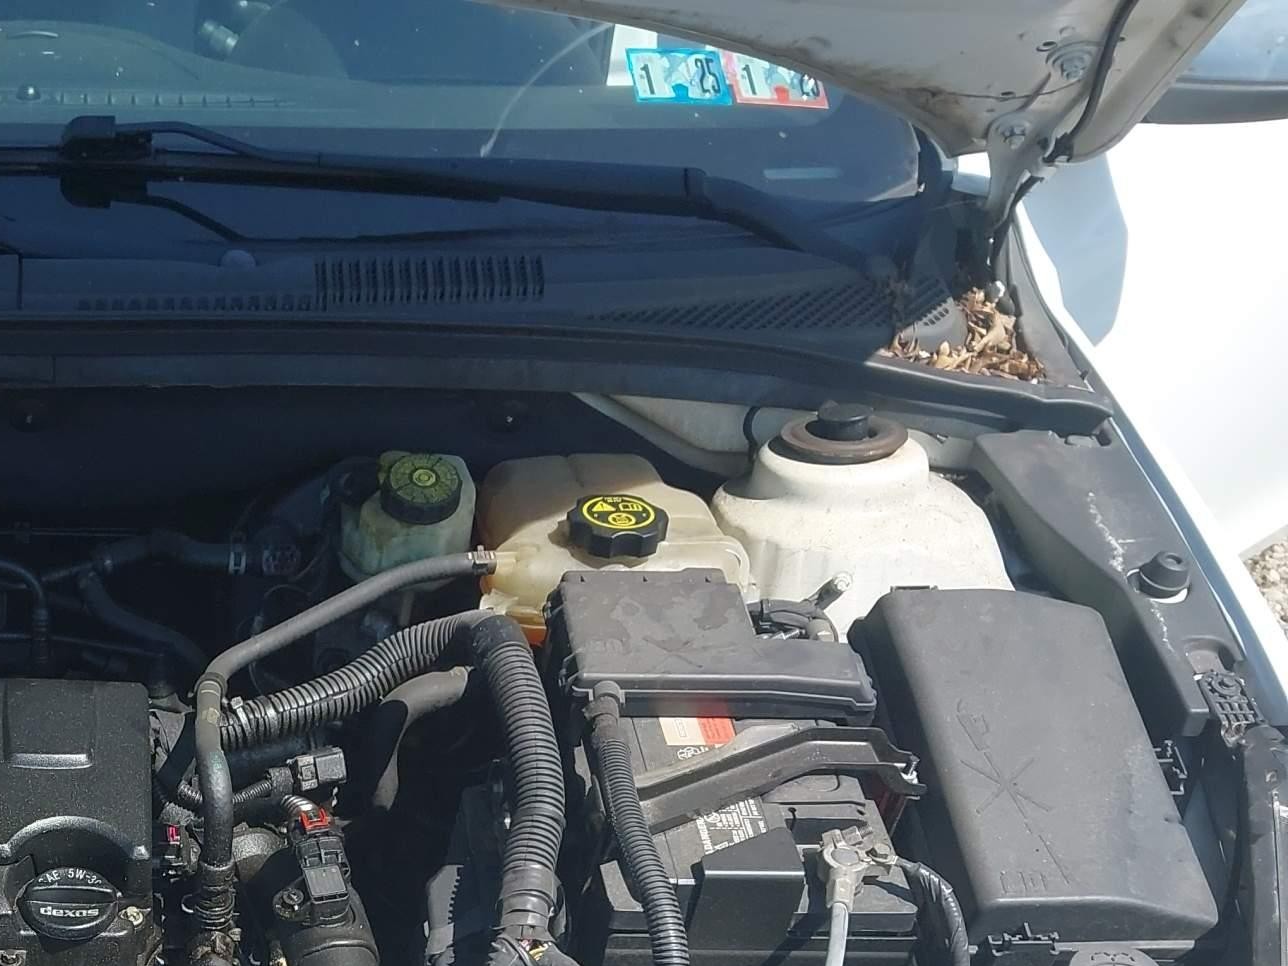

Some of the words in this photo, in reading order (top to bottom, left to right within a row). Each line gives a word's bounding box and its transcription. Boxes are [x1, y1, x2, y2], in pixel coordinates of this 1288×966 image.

[640, 63, 655, 95] 1
[695, 57, 721, 96] 25
[742, 64, 757, 96] 1
